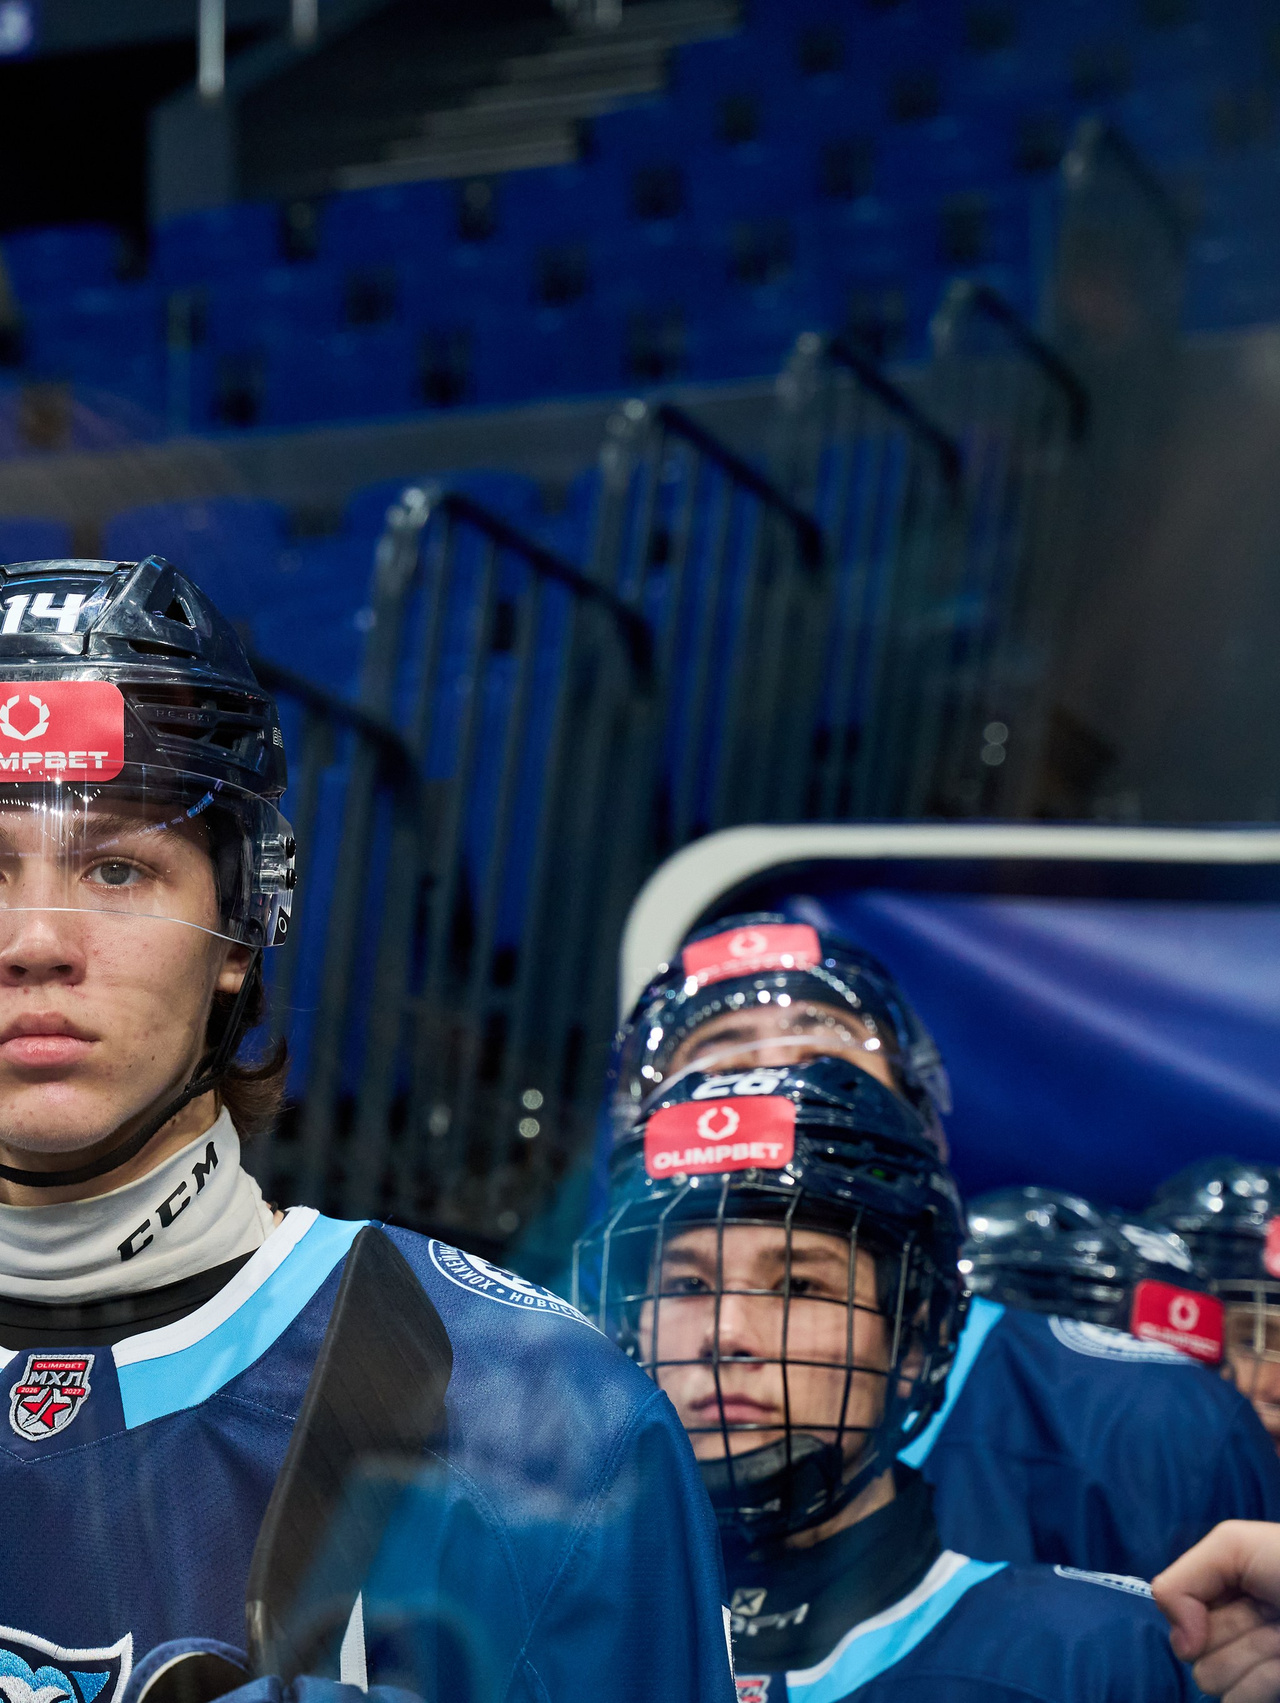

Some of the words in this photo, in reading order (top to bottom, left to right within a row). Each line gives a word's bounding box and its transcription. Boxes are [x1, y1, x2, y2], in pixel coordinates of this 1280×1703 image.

[1, 592, 87, 635] 14
[653, 1142, 784, 1170] OLIMPBET
[117, 1141, 219, 1262] CCM
[27, 1371, 84, 1386] МХЛ
